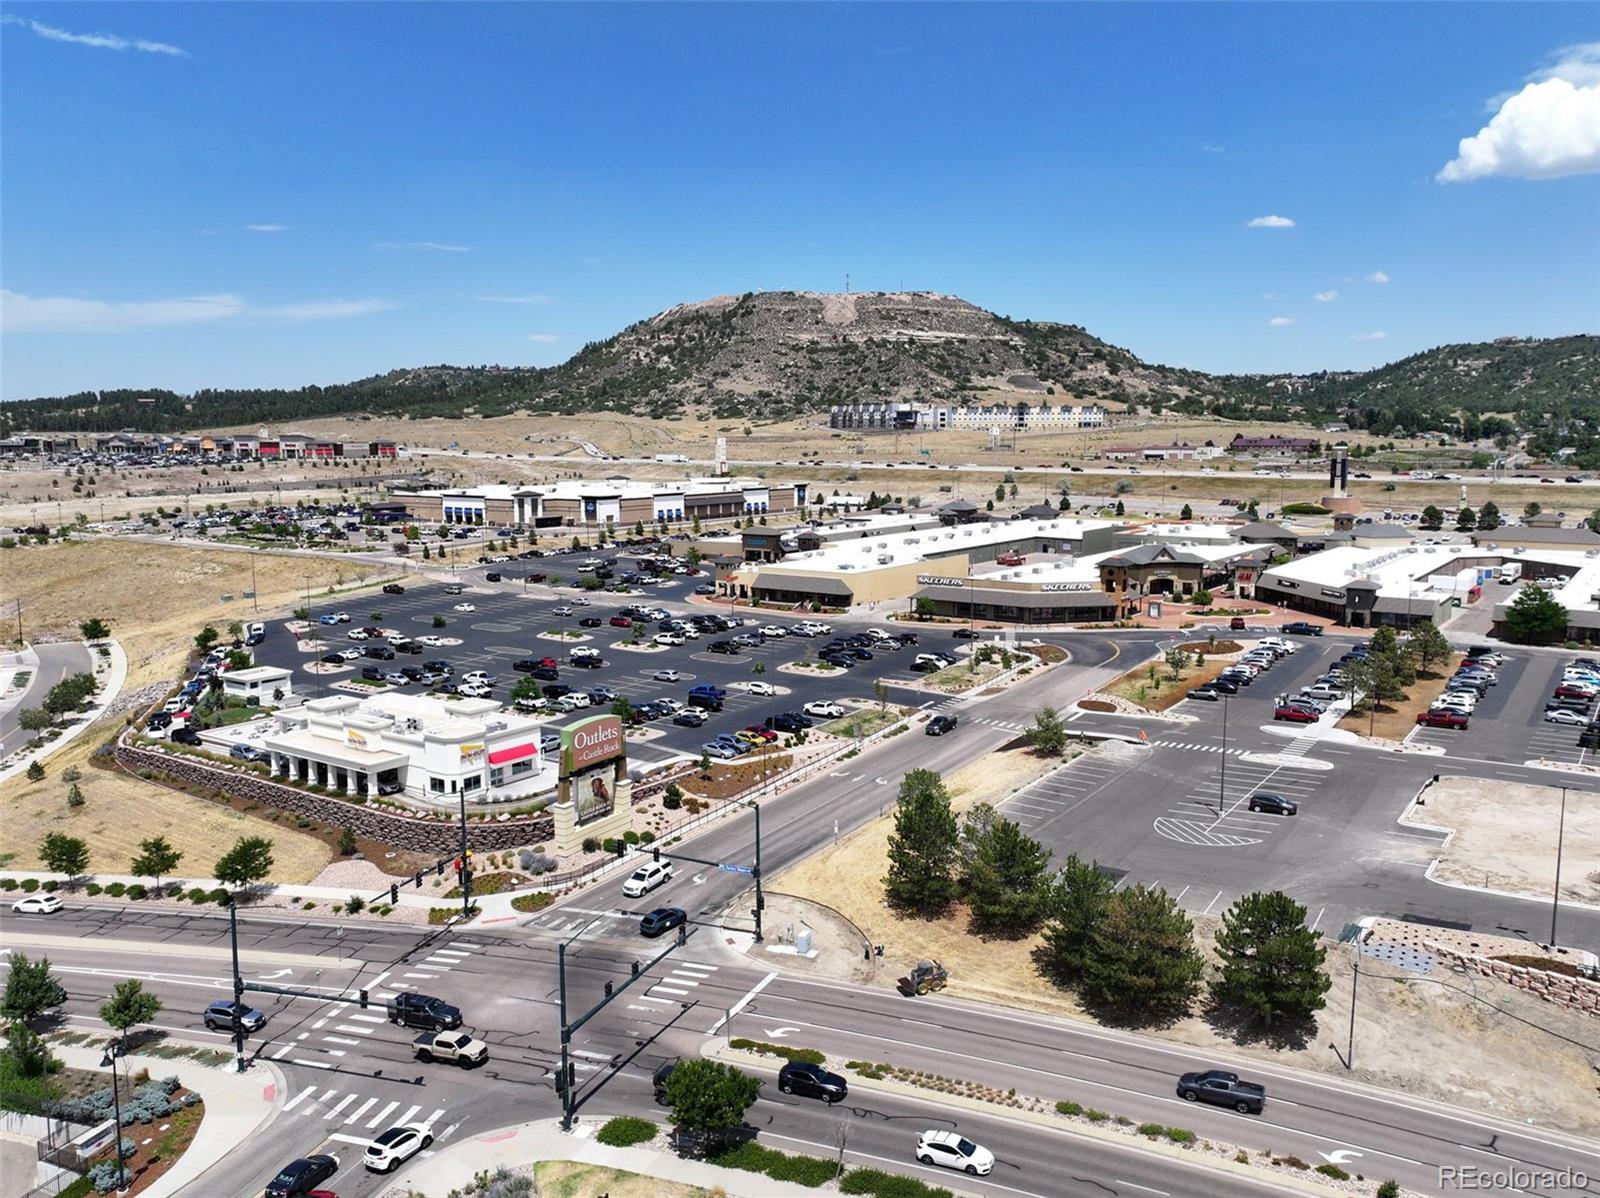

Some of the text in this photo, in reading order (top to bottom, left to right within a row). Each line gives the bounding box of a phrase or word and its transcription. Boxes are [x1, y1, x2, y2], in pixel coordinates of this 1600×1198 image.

[918, 576, 963, 586] SKECHERS
[1040, 582, 1092, 592] SKECHERS
[574, 724, 618, 749] Outlets
[583, 746, 603, 761] Castle
[603, 740, 621, 754] Rock
